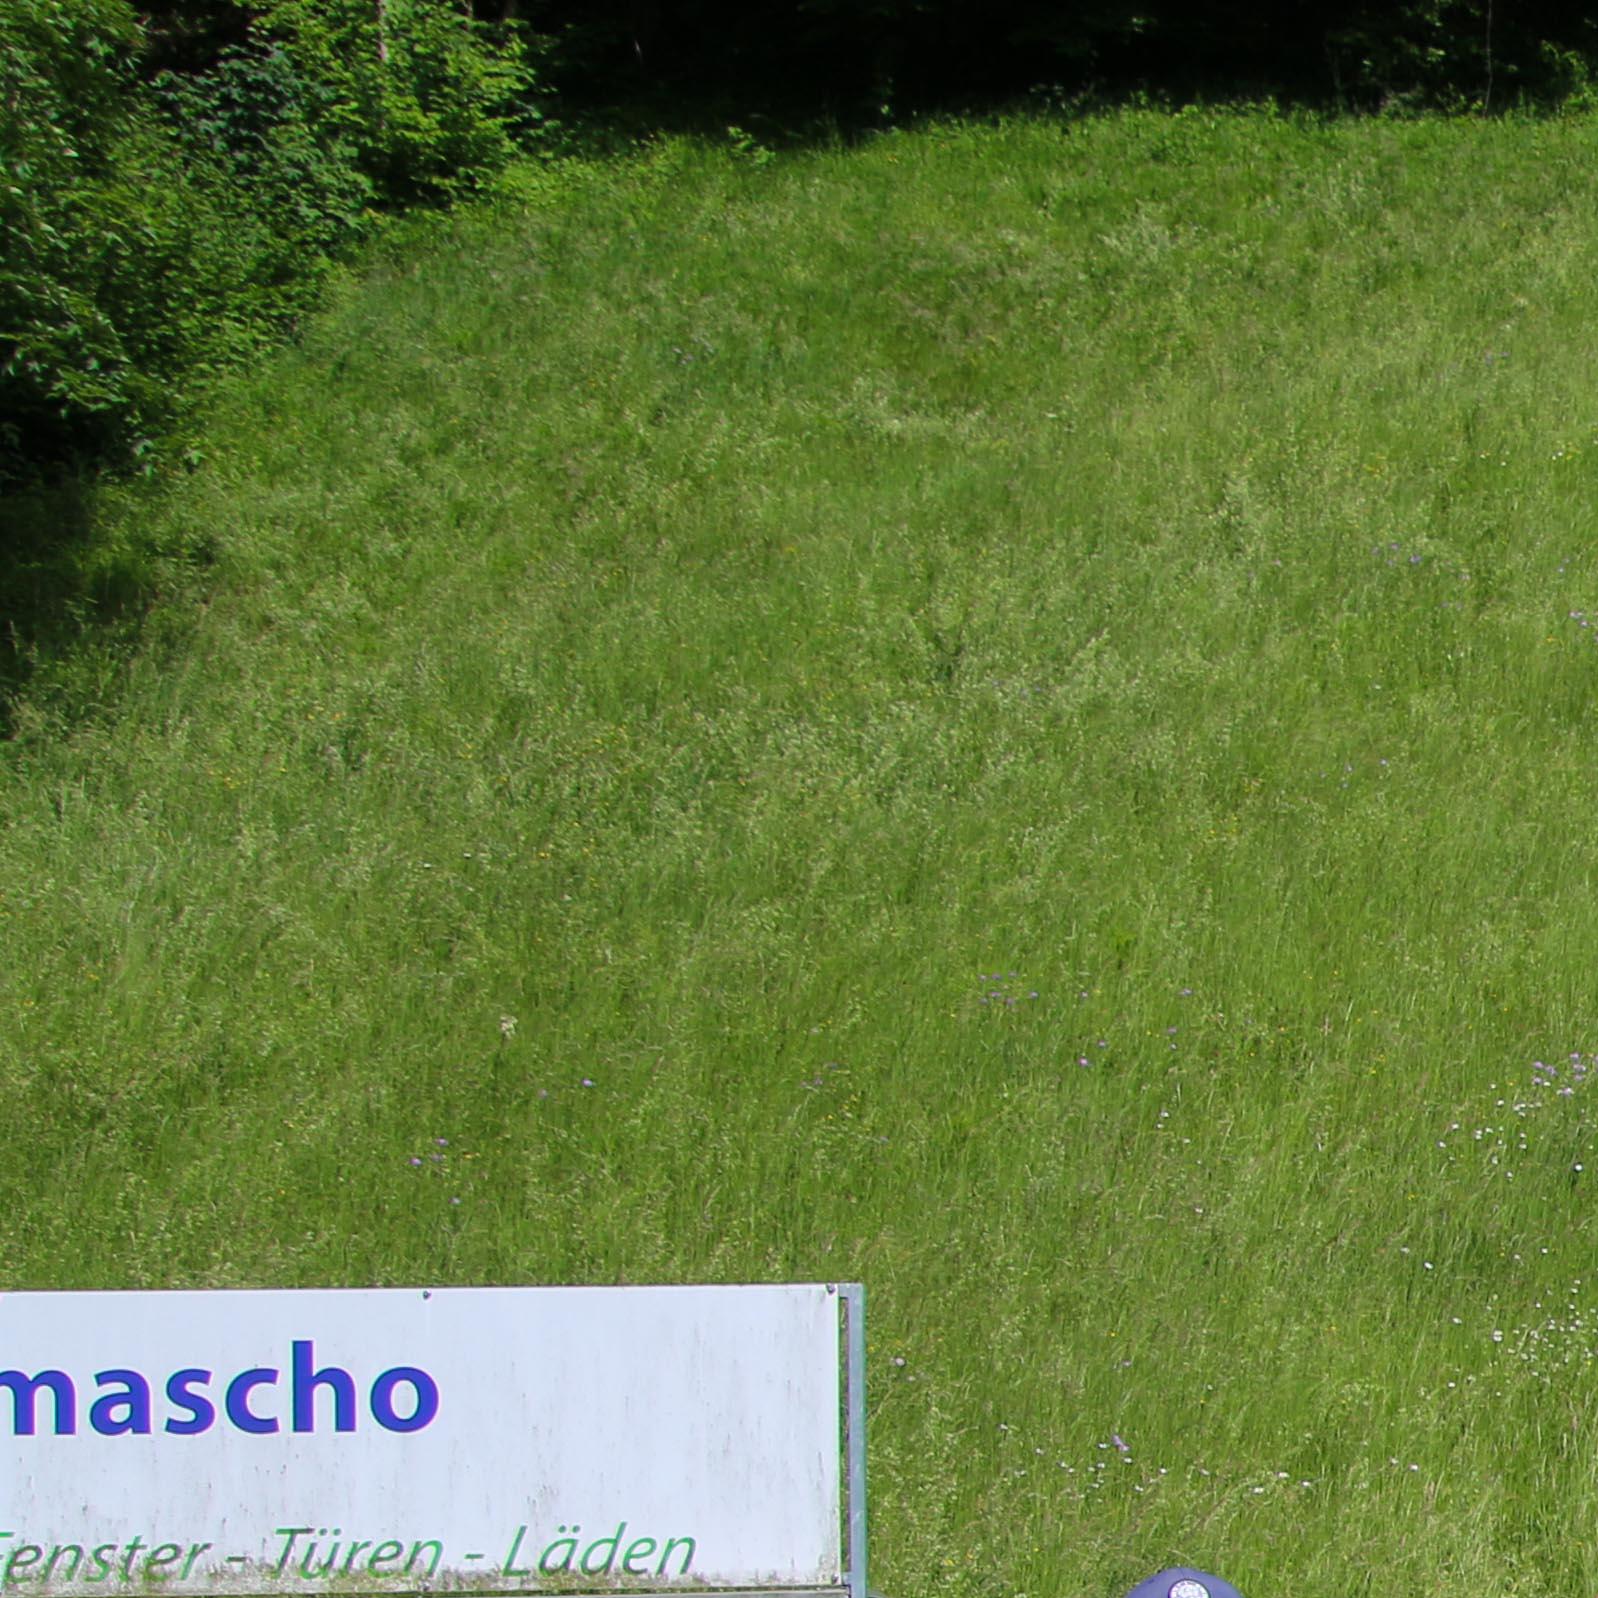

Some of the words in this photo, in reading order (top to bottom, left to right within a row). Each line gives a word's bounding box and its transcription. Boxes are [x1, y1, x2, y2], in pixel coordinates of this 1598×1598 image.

[0, 1340, 439, 1436] mascho
[269, 1527, 443, 1580] Türen
[501, 1522, 697, 1578] Läden
